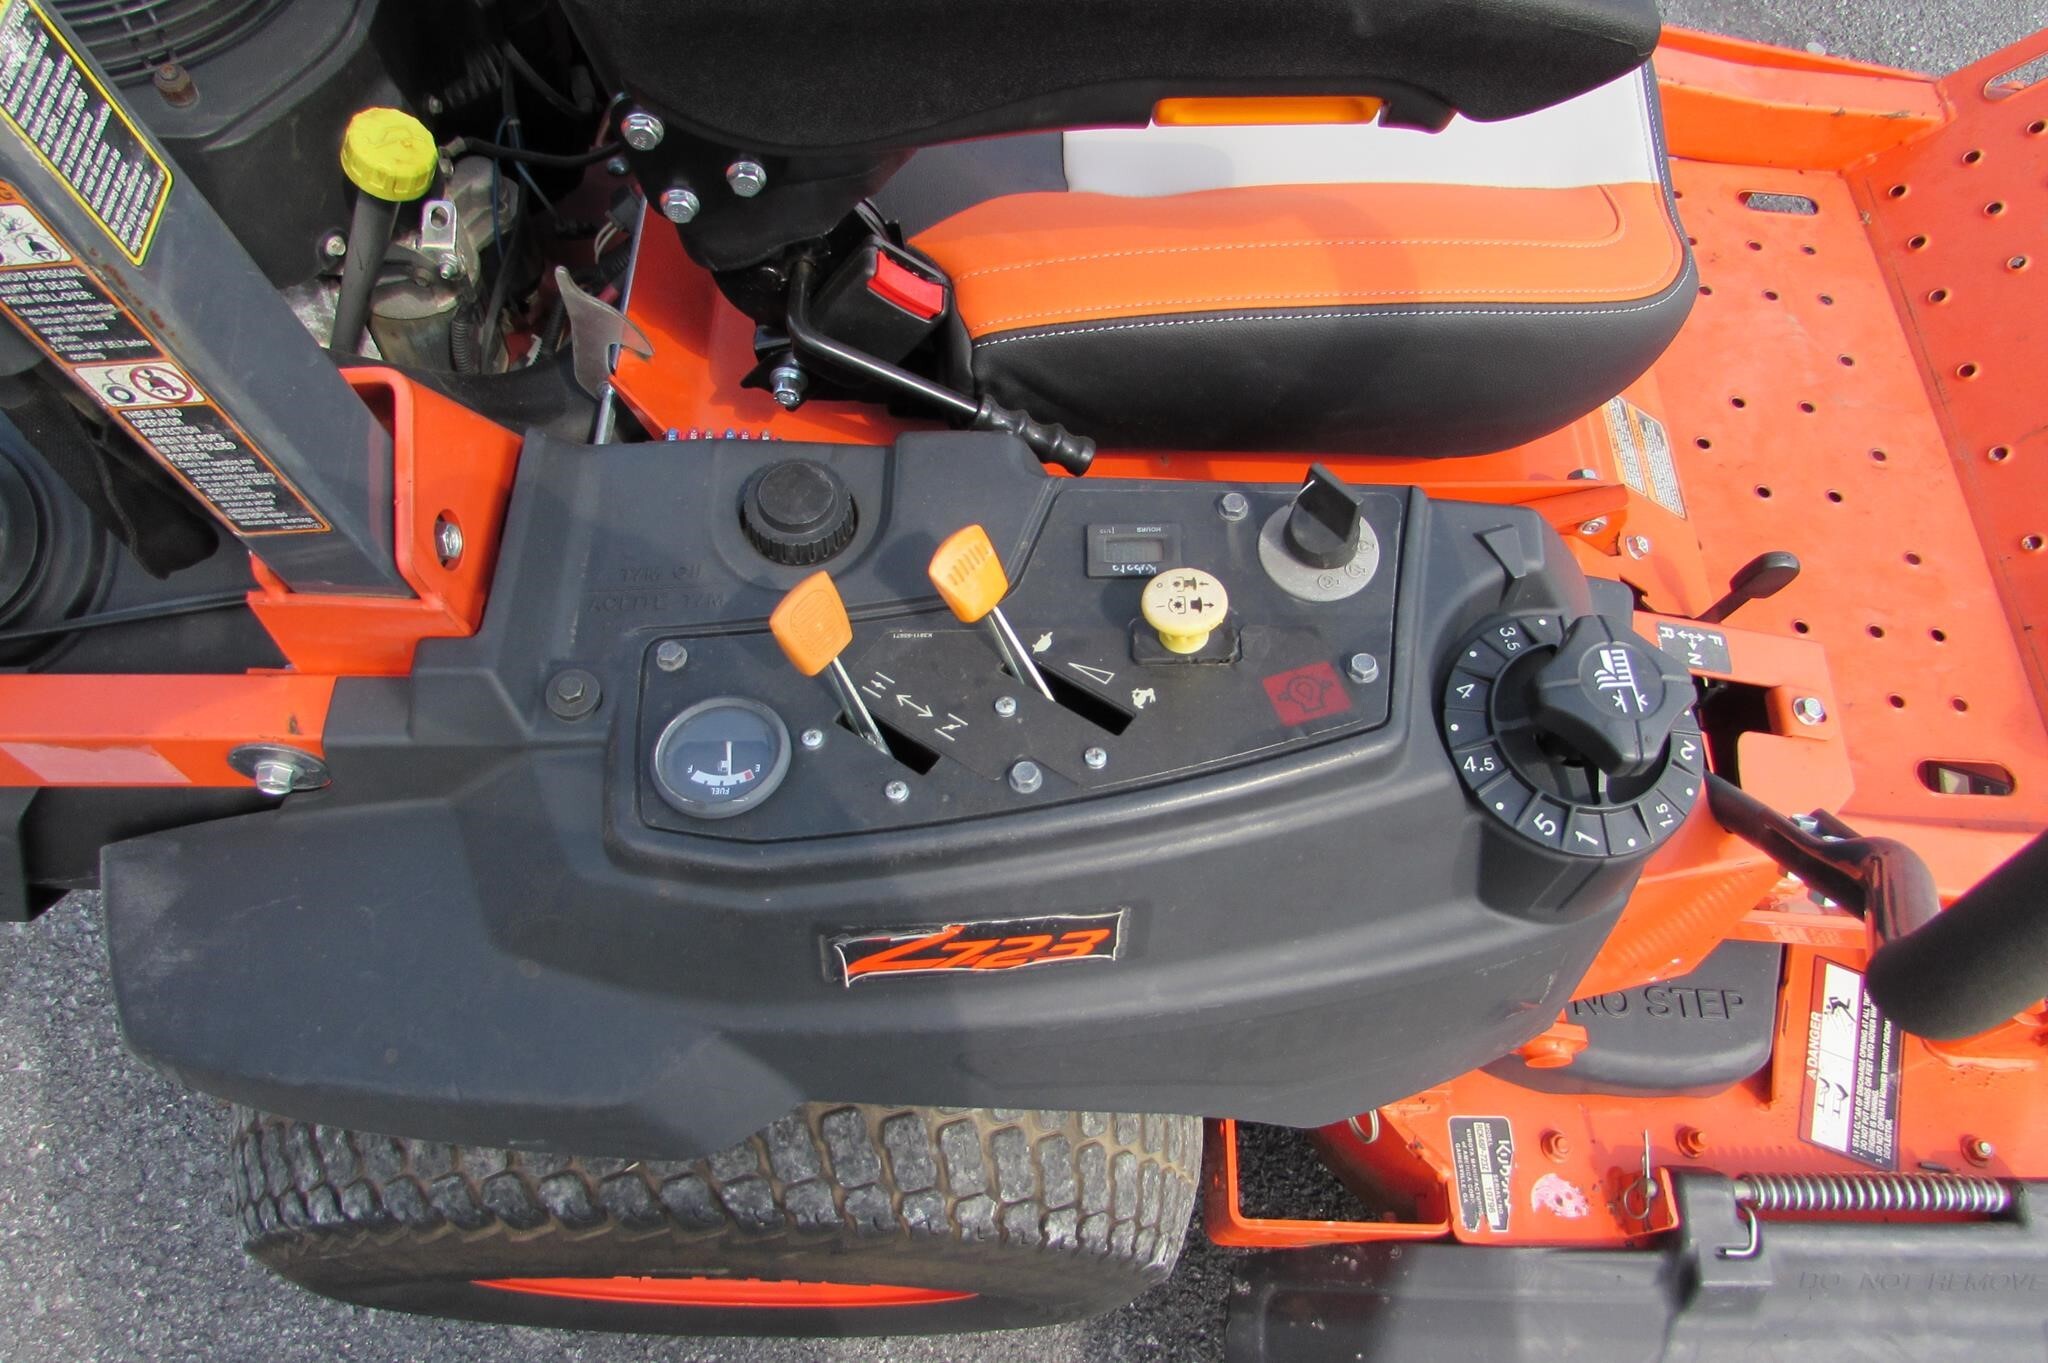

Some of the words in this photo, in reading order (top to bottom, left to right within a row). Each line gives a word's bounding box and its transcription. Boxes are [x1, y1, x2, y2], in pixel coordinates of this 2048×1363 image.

[27, 267, 84, 279] PERSONAL
[29, 282, 47, 291] OR
[46, 280, 83, 290] DEATH
[1, 294, 34, 305] FROM
[165, 407, 182, 416] NO
[131, 417, 184, 428] OPERATOR
[198, 441, 237, 451] FOLDED
[1112, 564, 1157, 574] Kubota
[1499, 626, 1521, 651] 3.5
[1659, 626, 1675, 639] R
[1708, 634, 1723, 647] F
[1687, 652, 1703, 666] N
[1456, 682, 1475, 699] 4
[1681, 740, 1696, 761] 2
[687, 764, 693, 773] F
[754, 763, 761, 773] E
[1463, 756, 1495, 773] 4.5
[711, 787, 730, 795] FUEL
[1655, 803, 1674, 828] 1.5
[1533, 813, 1556, 836] 5
[1574, 830, 1599, 846] 1
[847, 926, 1111, 975] Z723
[1643, 985, 1745, 1020] STEP
[1861, 1006, 1869, 1020] ALL
[1860, 1019, 1868, 1030] AT
[1867, 1017, 1876, 1044] MOWER
[1806, 1009, 1821, 1069] DANGER
[1858, 1028, 1868, 1058] OPENING
[1866, 1042, 1874, 1060] INTO
[1880, 1041, 1889, 1074] WITHOUT
[1865, 1058, 1873, 1077] FEET
[1855, 1057, 1866, 1096] DISCHARGE
[1864, 1075, 1872, 1088] OR
[1878, 1071, 1887, 1099] MOWER
[1855, 1095, 1863, 1107] OF
[1862, 1086, 1871, 1111] HANDS
[1861, 1108, 1870, 1125] PUT
[1876, 1097, 1886, 1131] OPERATE
[1852, 1129, 1861, 1148] STAY
[1860, 1124, 1869, 1140] NOT
[1867, 1127, 1876, 1154] ENGINE
[1875, 1129, 1884, 1146] NOT
[1464, 1128, 1474, 1156] KUBOTA
[1859, 1139, 1868, 1151] DO
[1874, 1144, 1883, 1156] DO
[1461, 1150, 1471, 1182] AMERICA
[1798, 1270, 1841, 1290] DO
[1859, 1271, 1912, 1291] NOT
[1927, 1271, 2044, 1292] REMOVE
